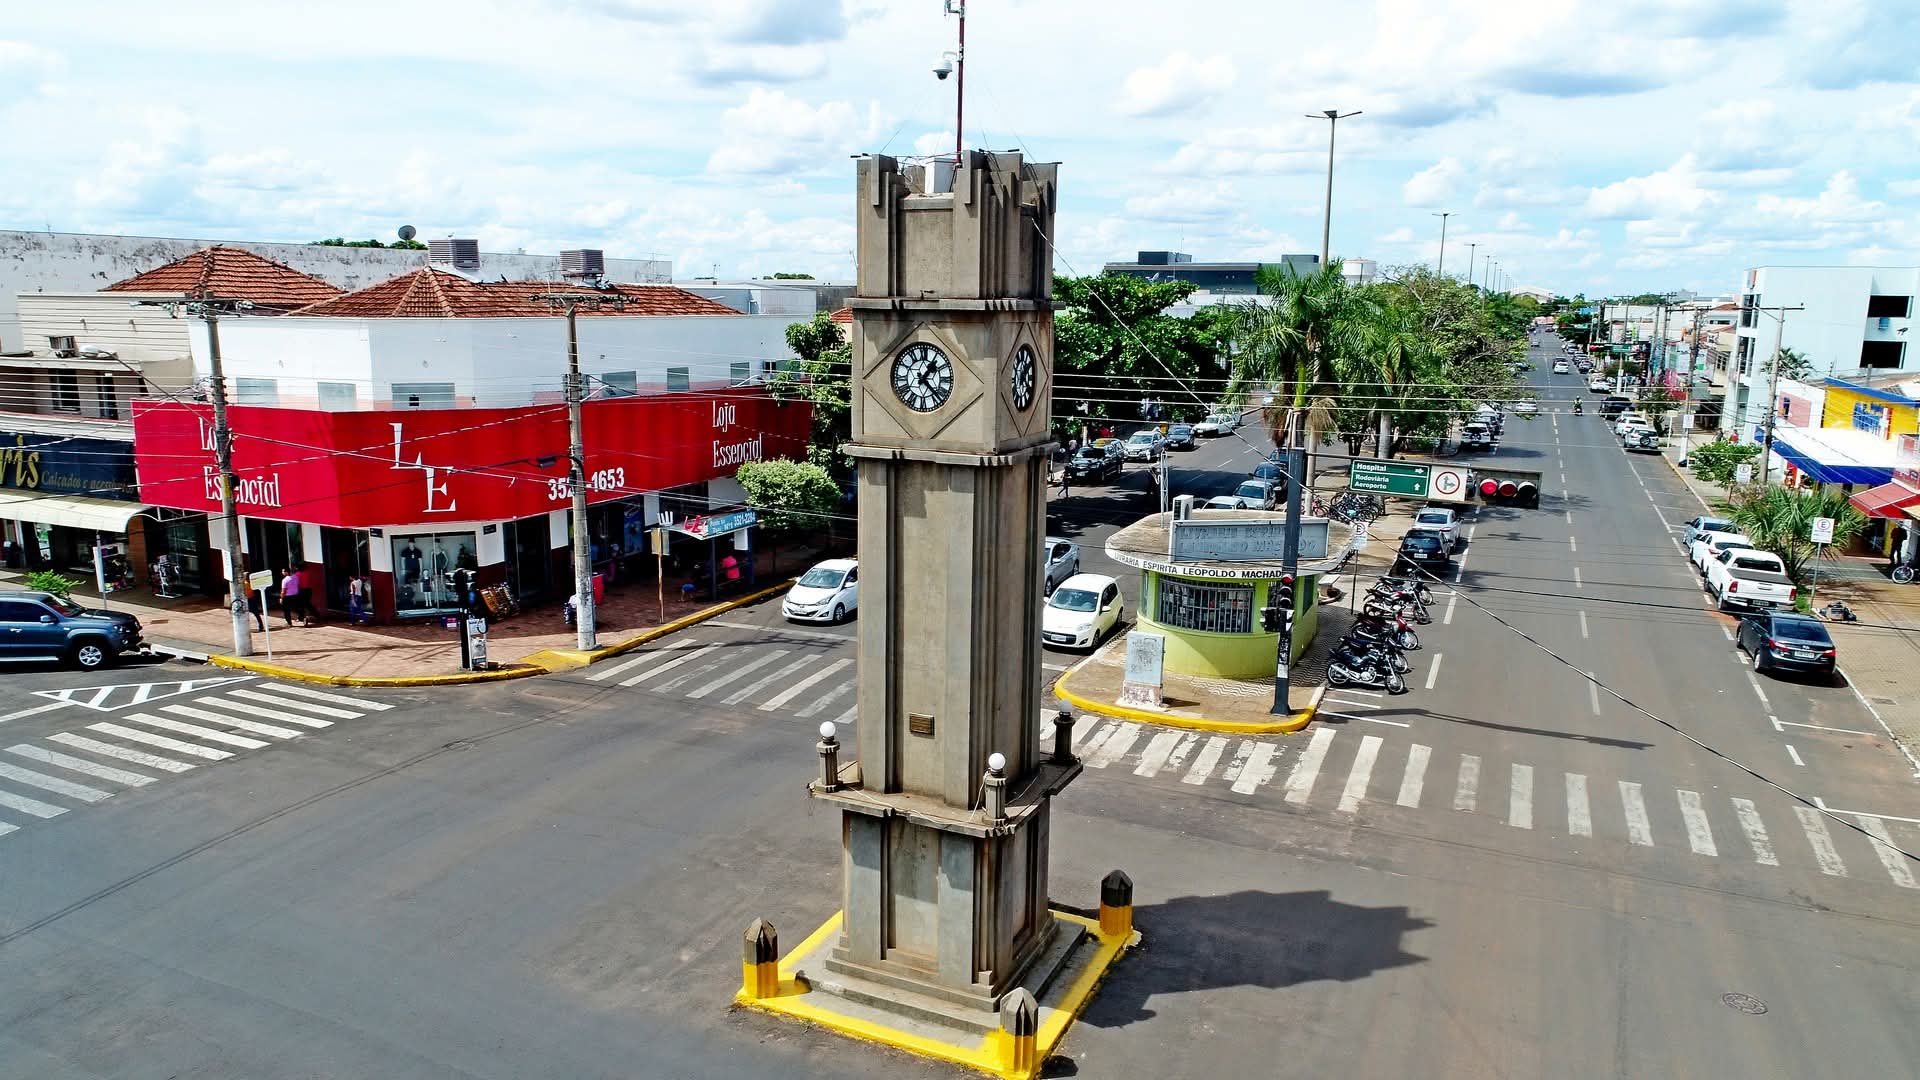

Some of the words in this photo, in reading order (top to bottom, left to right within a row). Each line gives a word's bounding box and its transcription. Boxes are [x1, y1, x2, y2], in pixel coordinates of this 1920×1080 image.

[712, 399, 736, 432] Loja
[713, 432, 763, 468] Essencial
[1355, 474, 1389, 483] Rodoviária
[1356, 463, 1387, 472] Hospital
[203, 466, 282, 507] Esncial
[547, 467, 625, 500] 352-1653
[1354, 482, 1387, 490] Aeroporto
[1143, 561, 1178, 574] ESPIRITA
[1183, 567, 1236, 578] LEOPOLDO
[1241, 570, 1282, 578] MACHAD
